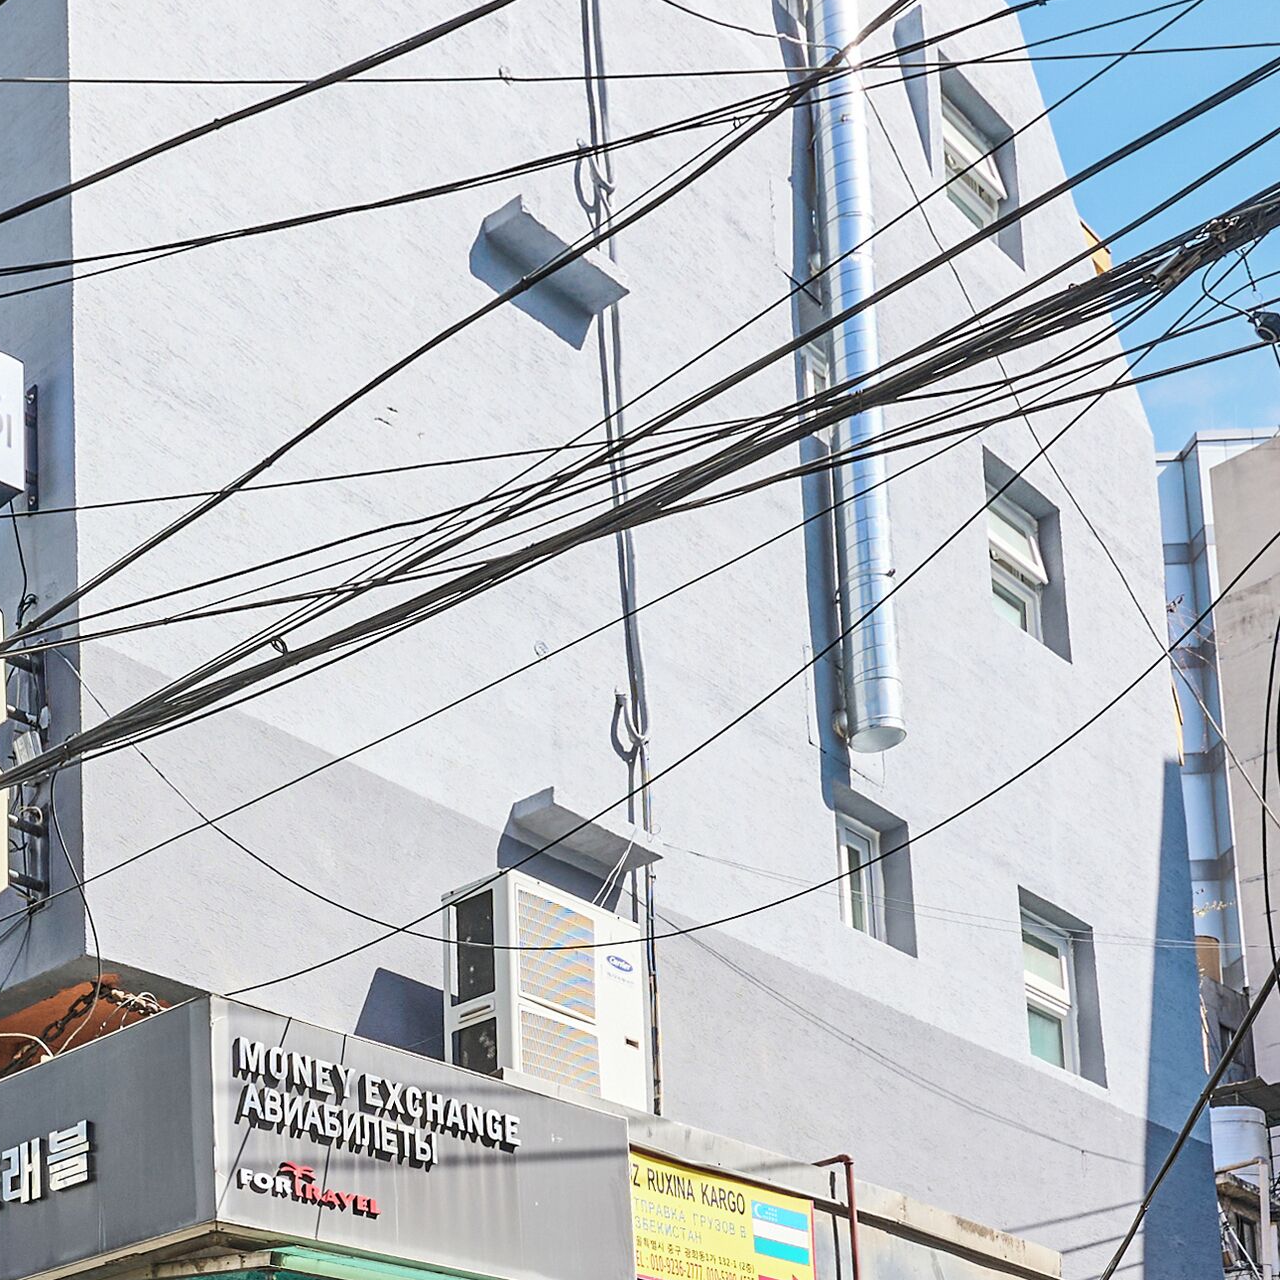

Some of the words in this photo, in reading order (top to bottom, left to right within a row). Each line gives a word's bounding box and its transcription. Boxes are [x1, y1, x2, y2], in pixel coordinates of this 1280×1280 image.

[237, 1036, 355, 1099] MONEY
[364, 1072, 521, 1147] EXCHANGE
[241, 1083, 439, 1165] АВИАБИЛЕТЫ
[647, 1167, 696, 1203] RUXINA
[701, 1182, 746, 1216] KARGO
